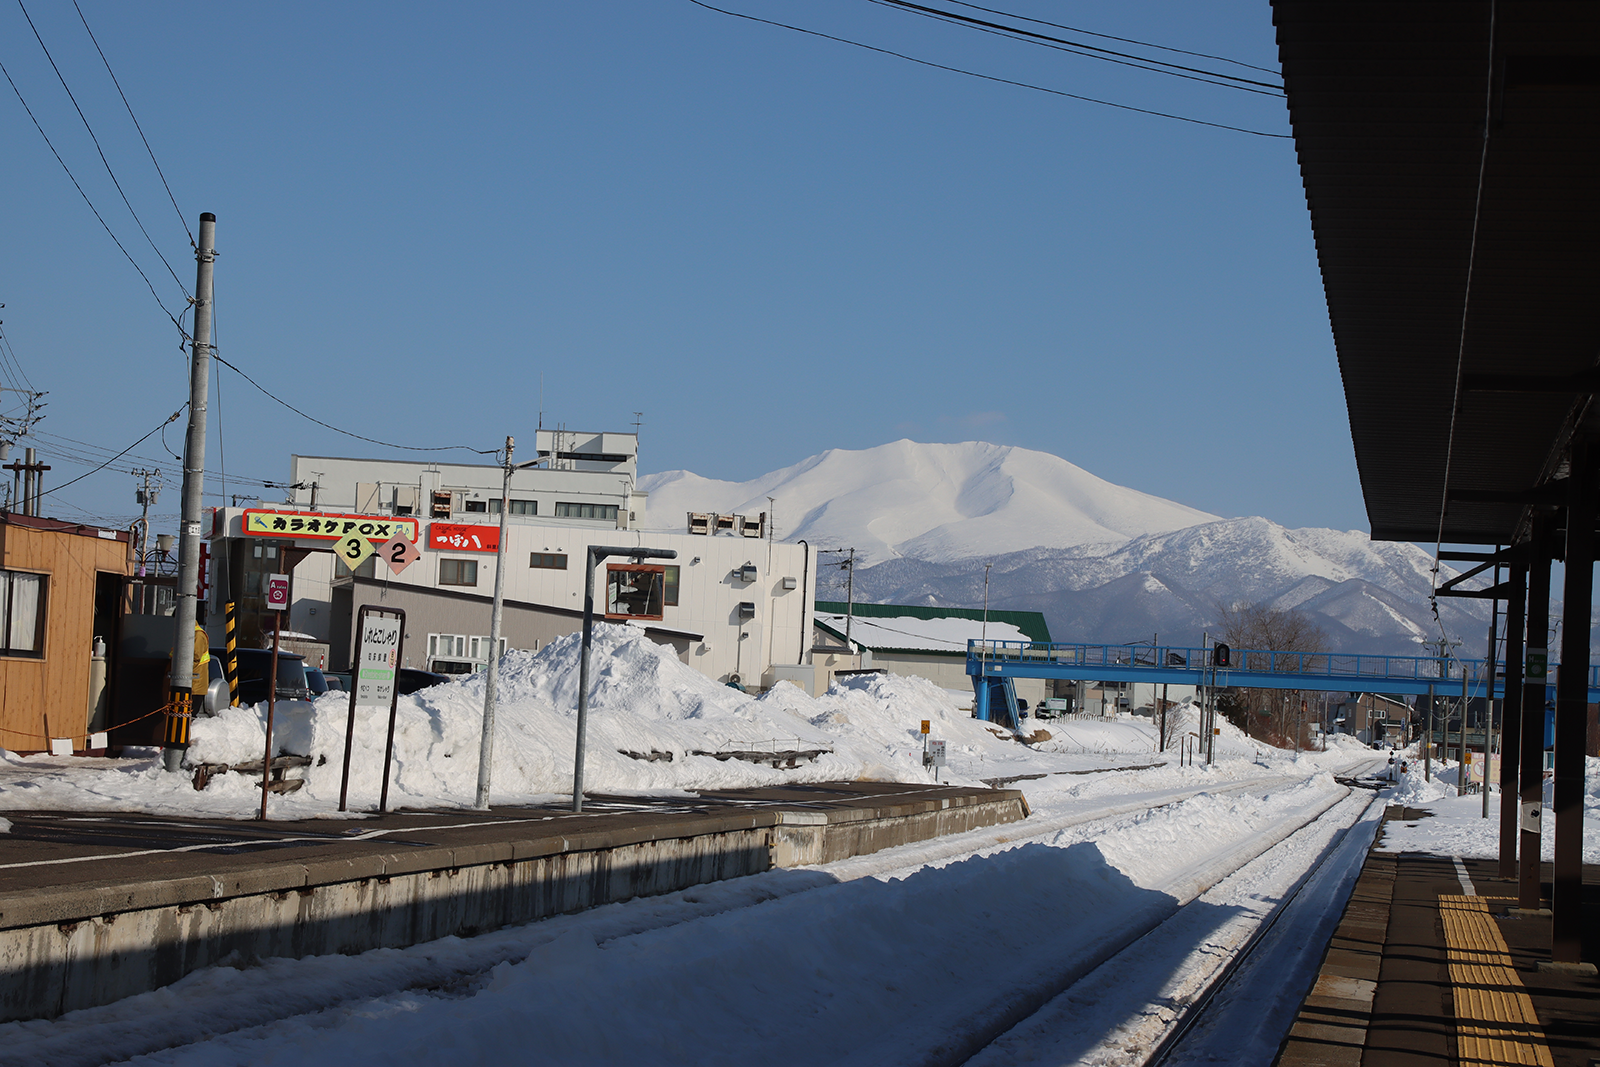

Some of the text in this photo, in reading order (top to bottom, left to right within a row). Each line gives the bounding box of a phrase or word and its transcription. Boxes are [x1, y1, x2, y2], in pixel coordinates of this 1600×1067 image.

[346, 538, 361, 559] 3
[436, 534, 482, 549] つぼ八
[391, 542, 406, 563] 2
[364, 627, 397, 645] しれとこしゃり
